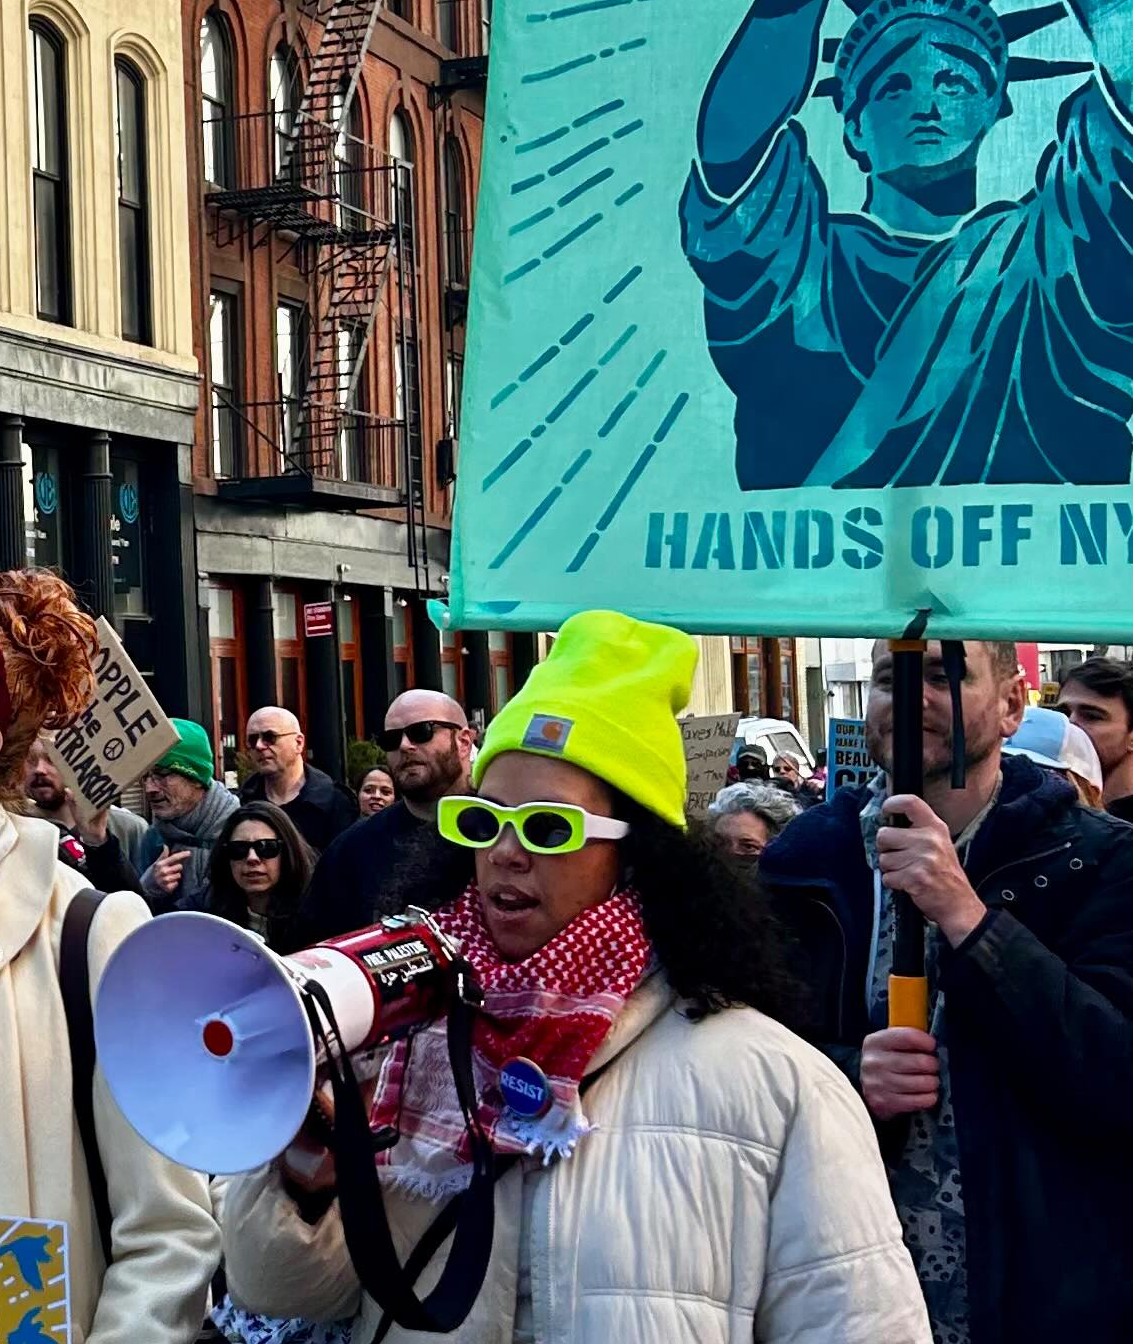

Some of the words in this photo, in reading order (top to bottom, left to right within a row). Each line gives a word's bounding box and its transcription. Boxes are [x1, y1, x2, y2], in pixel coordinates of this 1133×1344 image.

[644, 506, 884, 571] HANDS
[911, 504, 1034, 569] OFF
[80, 699, 102, 739] he
[95, 647, 158, 748] OPPLE
[500, 1070, 544, 1102] RESIST
